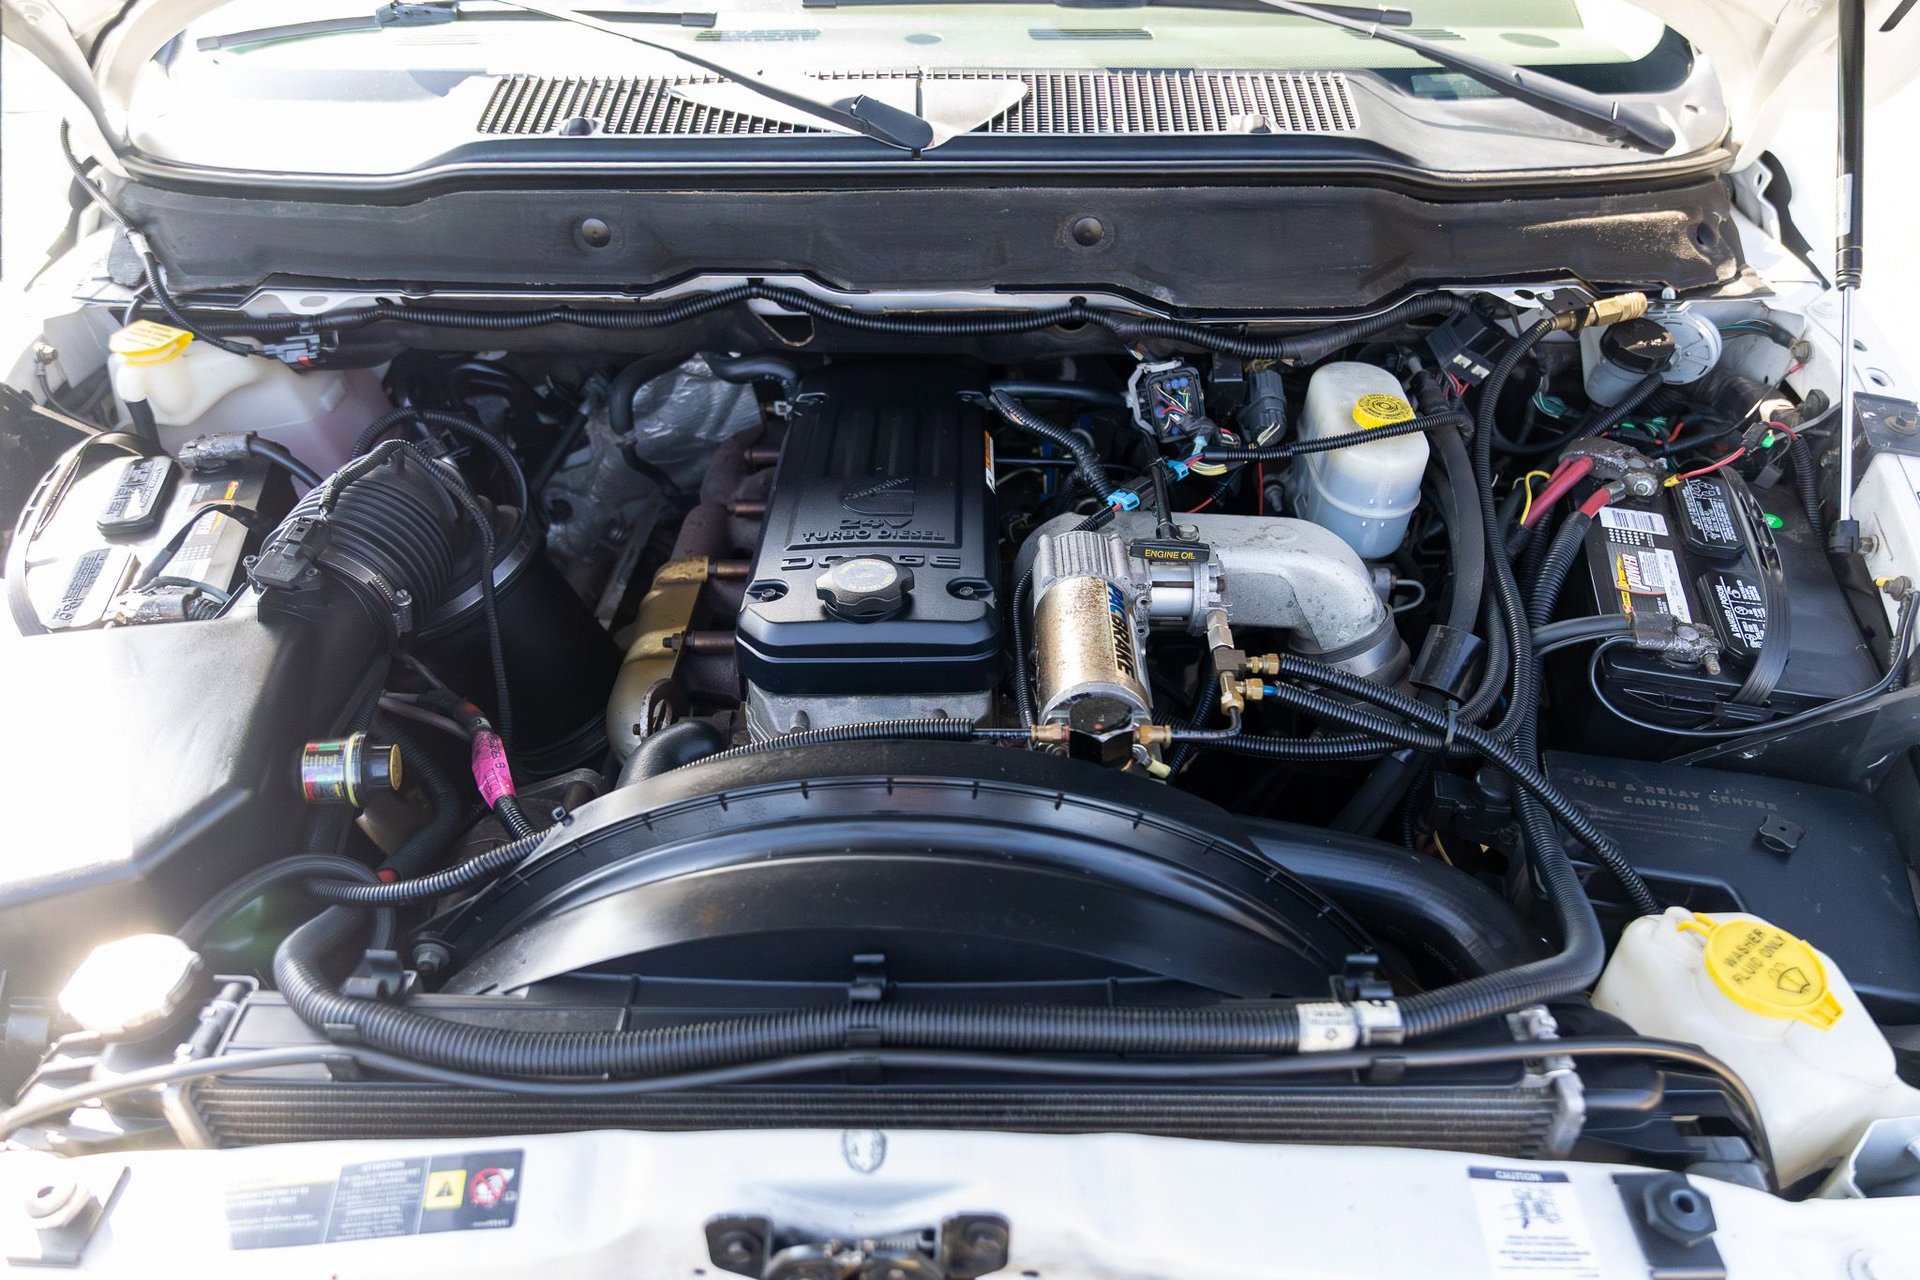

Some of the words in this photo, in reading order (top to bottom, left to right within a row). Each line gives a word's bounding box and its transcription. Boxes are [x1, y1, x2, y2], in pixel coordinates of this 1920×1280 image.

[839, 518, 913, 530] 24V
[803, 530, 871, 542] TURBO
[877, 529, 946, 541] DIESEL
[781, 552, 961, 572] DOGE
[1144, 549, 1179, 560] ENGINE
[1181, 551, 1196, 560] OIL
[1106, 580, 1135, 680] PACBRAKE
[1573, 776, 1617, 790] FUSE
[1644, 785, 1701, 799] RELAY
[1708, 793, 1778, 812] CENTER
[1622, 795, 1700, 813] CAUTION
[1724, 928, 1765, 968] WASHER
[1732, 956, 1763, 985] FLUID
[1758, 934, 1786, 959] ONLY
